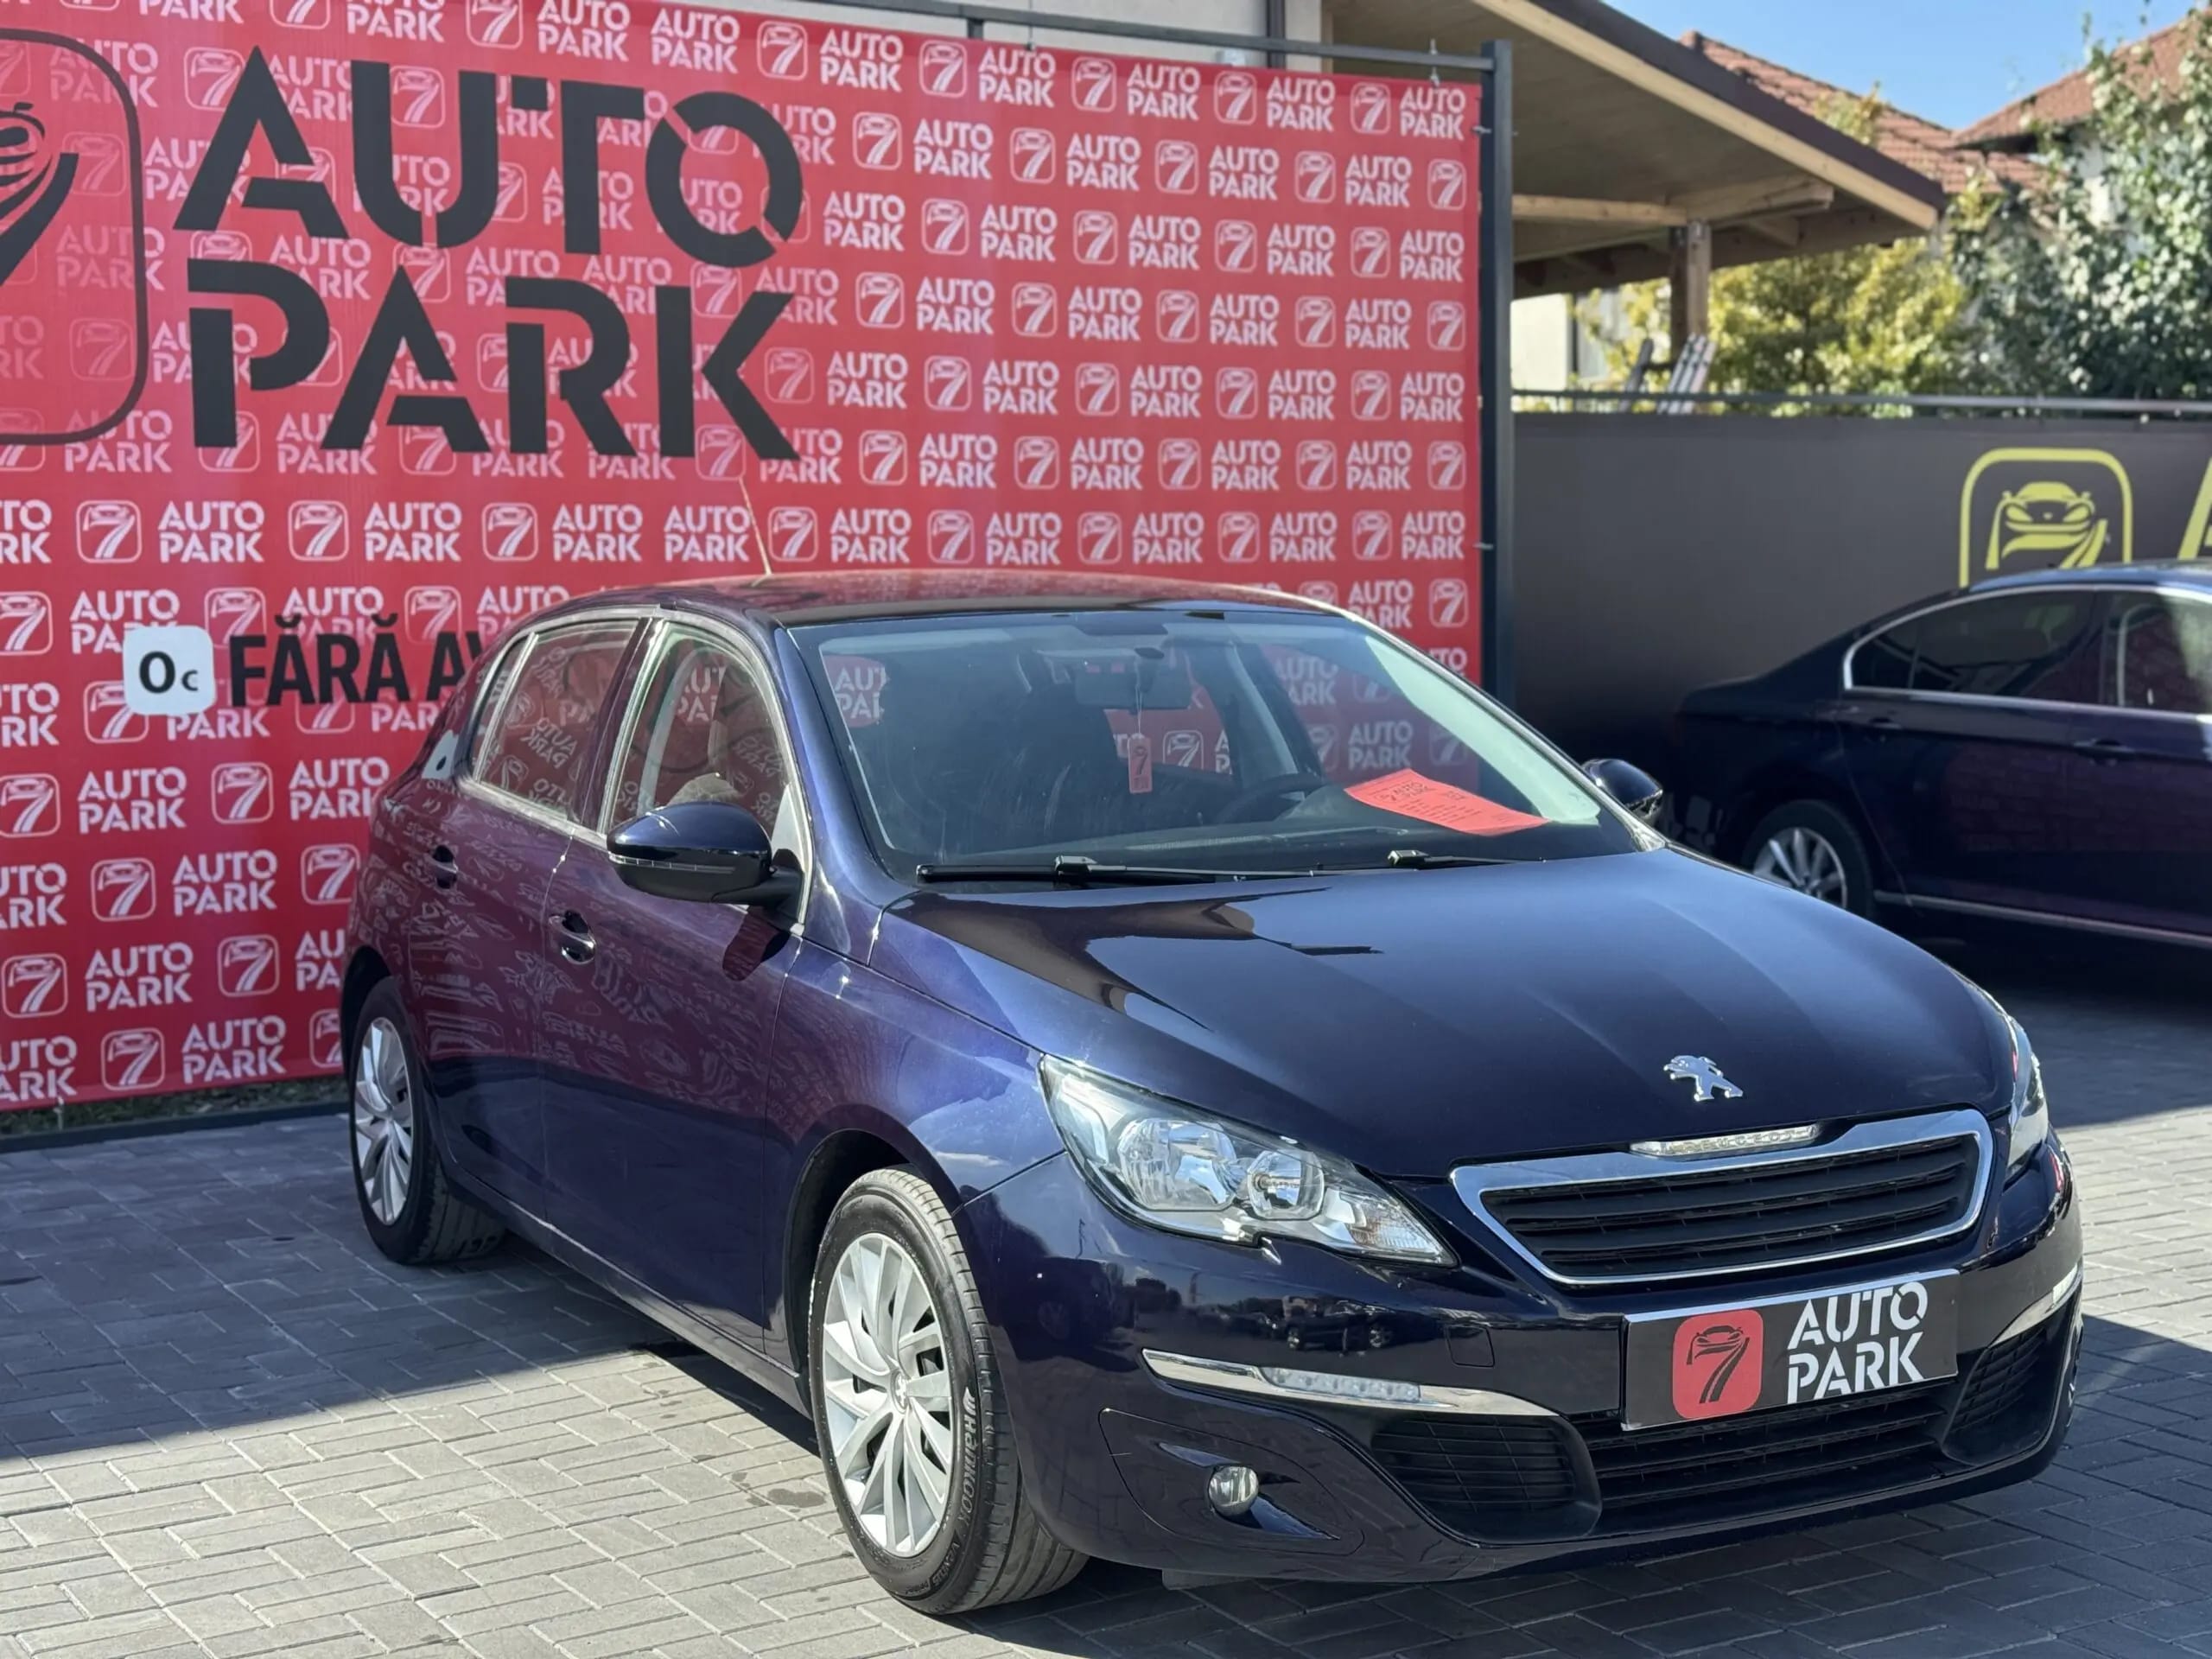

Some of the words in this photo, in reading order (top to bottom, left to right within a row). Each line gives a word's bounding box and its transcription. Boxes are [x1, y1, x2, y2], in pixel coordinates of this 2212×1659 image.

[347, 7, 445, 42] PARK
[537, 0, 630, 30] AUTO
[651, 7, 741, 43] AUTO
[538, 23, 629, 62] PARK
[652, 36, 738, 74] PARK
[820, 29, 906, 62] AUTO
[821, 56, 902, 92] PARK
[979, 48, 1058, 79] AUTO
[979, 73, 1054, 108] PARK
[1127, 65, 1200, 93] AUTO
[1267, 77, 1335, 105] AUTO
[1128, 88, 1198, 121] PARK
[1400, 87, 1466, 113] AUTO
[1267, 101, 1334, 131] PARK
[1401, 111, 1464, 141] PARK
[914, 118, 994, 150] AUTO
[1067, 133, 1141, 163] AUTO
[174, 46, 803, 268] AUTO
[914, 146, 992, 180] PARK
[1210, 145, 1279, 174] AUTO
[1345, 155, 1412, 182] AUTO
[1067, 160, 1139, 191] PARK
[1209, 171, 1277, 200] PARK
[823, 191, 906, 222] AUTO
[1345, 180, 1410, 207] PARK
[981, 204, 1058, 234] AUTO
[1128, 214, 1201, 243] AUTO
[824, 219, 904, 251] PARK
[981, 231, 1056, 262] PARK
[1268, 224, 1336, 250] AUTO
[1400, 230, 1465, 257] AUTO
[270, 235, 372, 268] AUTO
[466, 246, 560, 278] AUTO
[1129, 240, 1199, 270] PARK
[1268, 249, 1334, 276] PARK
[582, 255, 672, 285] AUTO
[756, 266, 839, 296] AUTO
[1400, 254, 1463, 283] PARK
[917, 276, 995, 307] AUTO
[1068, 286, 1142, 315] AUTO
[917, 303, 994, 335] PARK
[1210, 294, 1280, 320] AUTO
[1345, 299, 1412, 323] AUTO
[1069, 313, 1141, 341] PARK
[1210, 319, 1278, 346] PARK
[1345, 323, 1410, 350] PARK
[188, 257, 801, 460] PARK
[827, 352, 908, 380] AUTO
[983, 359, 1059, 388] AUTO
[1130, 365, 1202, 391] AUTO
[1268, 370, 1336, 394] AUTO
[1401, 372, 1465, 397] AUTO
[828, 378, 907, 410] PARK
[983, 386, 1058, 415] PARK
[1131, 391, 1201, 418] PARK
[1268, 394, 1334, 420] PARK
[1401, 397, 1463, 422] PARK
[65, 442, 173, 473] PARK
[277, 443, 378, 475] PARK
[919, 433, 998, 461] AUTO
[1071, 437, 1144, 463] AUTO
[1211, 440, 1281, 465] AUTO
[1347, 441, 1412, 465] AUTO
[920, 460, 996, 489] PARK
[1071, 464, 1142, 490] PARK
[1211, 465, 1280, 491] PARK
[1346, 465, 1411, 490] PARK
[158, 501, 264, 531] AUTO
[365, 502, 461, 531] AUTO
[552, 504, 643, 532] AUTO
[664, 503, 752, 533] AUTO
[830, 508, 912, 536] AUTO
[986, 512, 1062, 538] AUTO
[1133, 512, 1205, 537] AUTO
[1270, 512, 1338, 537] AUTO
[1402, 511, 1465, 536] AUTO
[160, 532, 264, 563] PARK
[365, 532, 461, 562] PARK
[553, 533, 642, 562] PARK
[665, 533, 749, 562] PARK
[831, 536, 910, 563] PARK
[987, 538, 1060, 565] PARK
[1134, 537, 1203, 563] PARK
[1270, 537, 1336, 562] PARK
[1402, 535, 1465, 560] PARK
[71, 588, 180, 622] AUTO
[283, 587, 385, 617] AUTO
[476, 585, 570, 614] AUTO
[1349, 579, 1414, 604] AUTO
[230, 613, 410, 708] FĂRĂ
[167, 708, 270, 741] PARK
[1348, 721, 1413, 745] AUTO
[1348, 746, 1412, 769] PARK
[78, 766, 187, 802] AUTO
[289, 757, 390, 789] AUTO
[79, 798, 187, 834] PARK
[173, 849, 277, 885] AUTO
[175, 880, 276, 917] PARK
[86, 942, 194, 980] AUTO
[86, 973, 193, 1012] PARK
[182, 1015, 286, 1053] AUTO
[183, 1046, 287, 1084] PARK
[1788, 1282, 1928, 1351] AUTO
[1787, 1332, 1923, 1404] PARK
